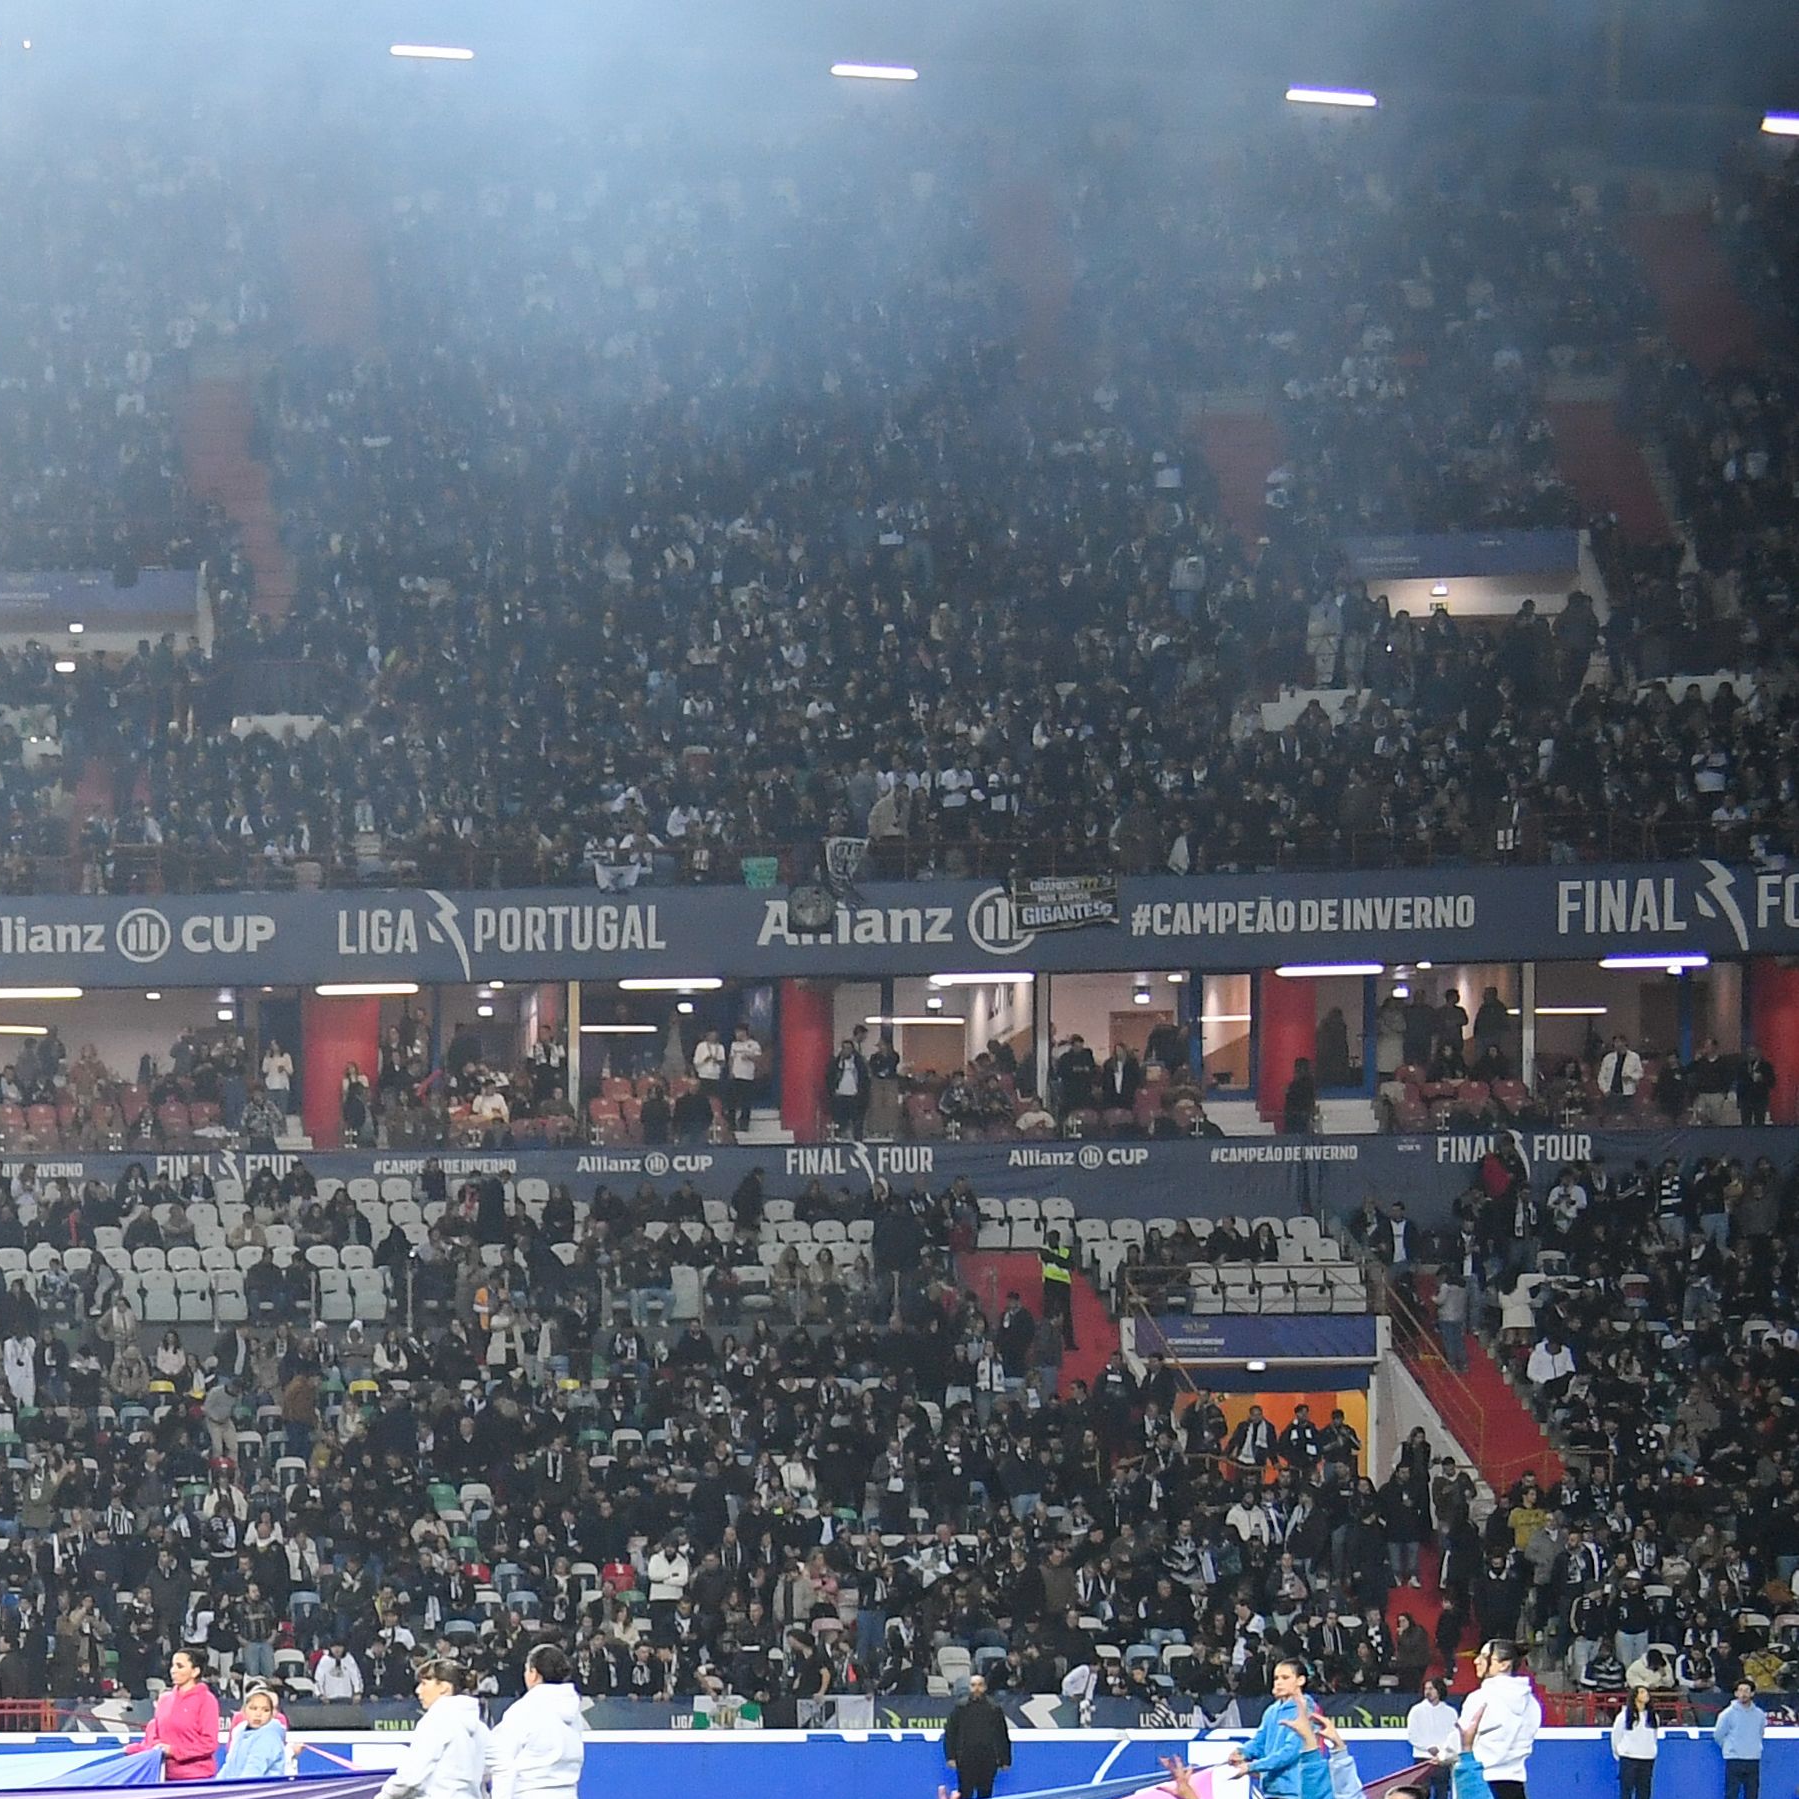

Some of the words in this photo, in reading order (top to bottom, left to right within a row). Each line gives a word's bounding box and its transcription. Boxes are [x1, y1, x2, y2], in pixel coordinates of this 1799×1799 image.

[1558, 878, 1687, 934] FINAL
[1757, 874, 1799, 930] FO
[182, 916, 275, 953] CUP
[338, 907, 418, 954] LIGA
[473, 904, 665, 952] PORTUGAL
[757, 900, 953, 947] Aianz
[576, 1156, 641, 1172] Allianz
[672, 1156, 713, 1172] CUP
[786, 1147, 847, 1175] FINAL
[877, 1146, 933, 1173] FOUR
[1008, 1149, 1074, 1166] Allianz
[1107, 1148, 1149, 1165] CUP
[1533, 1135, 1591, 1160] FOUR
